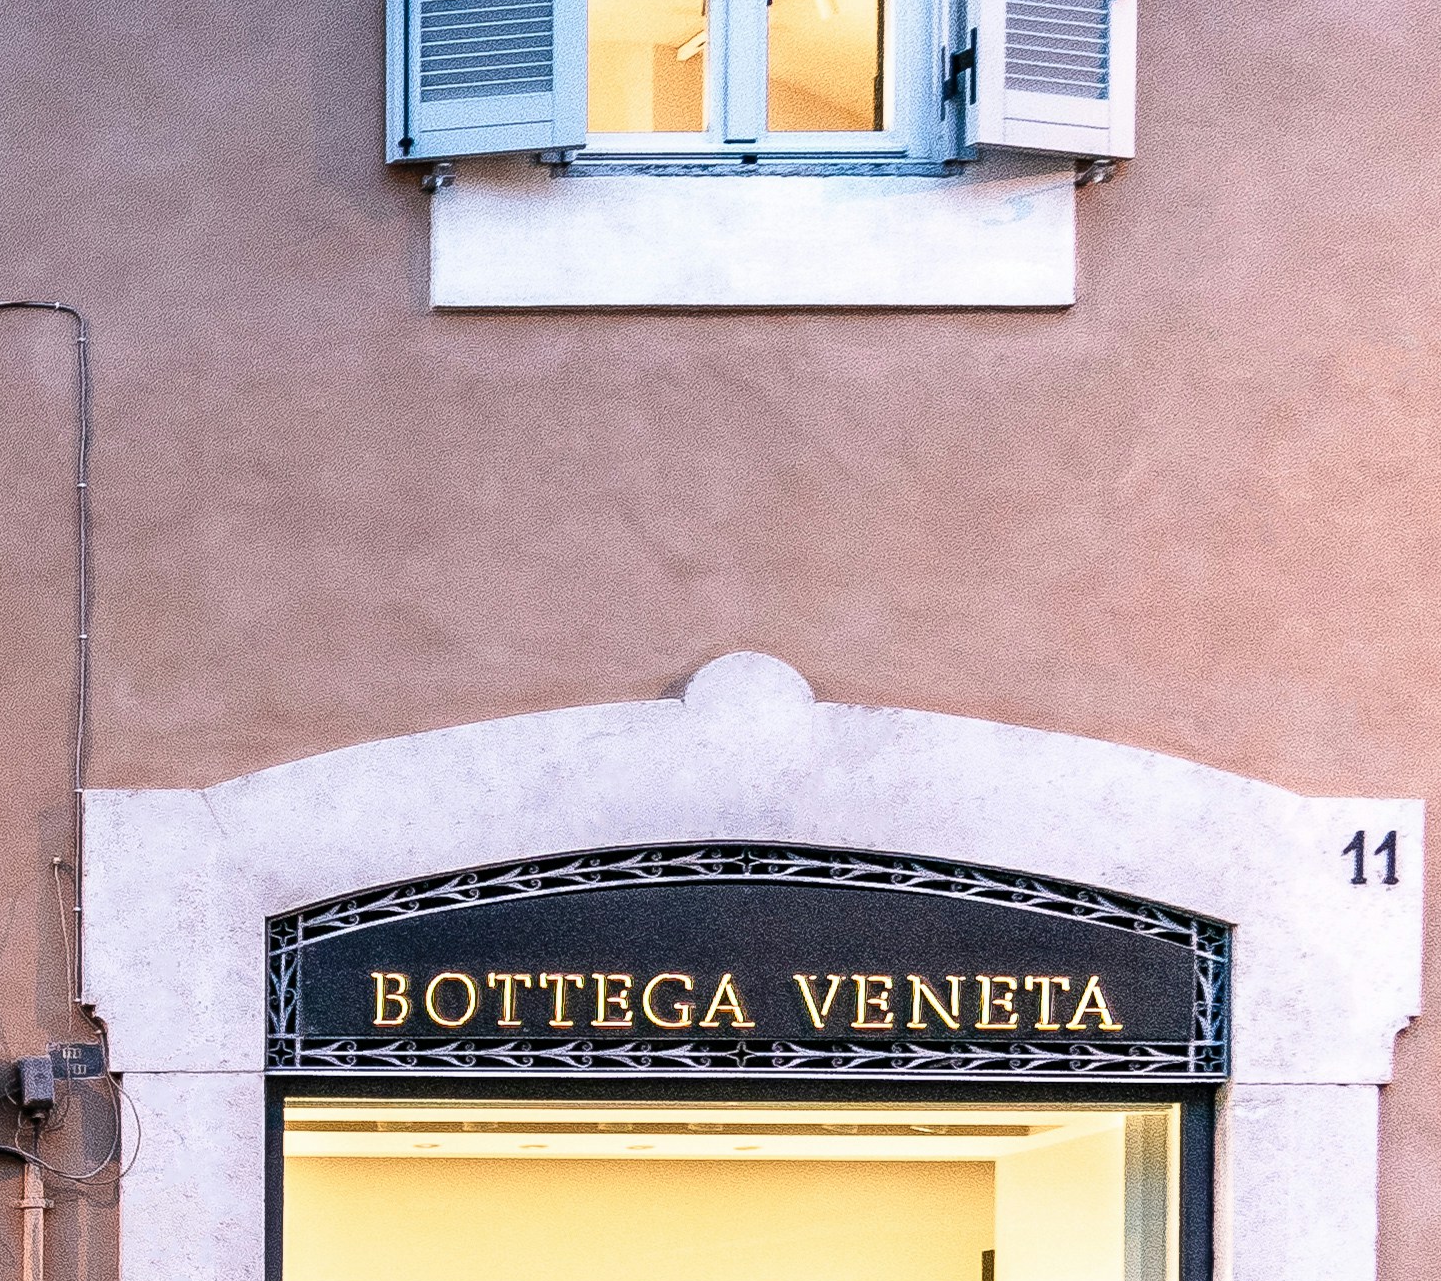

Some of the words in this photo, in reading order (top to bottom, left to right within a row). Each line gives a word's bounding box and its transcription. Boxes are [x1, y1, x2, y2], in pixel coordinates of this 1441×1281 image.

[1340, 829, 1399, 885] 11
[370, 971, 756, 1029] BOTTEGA
[792, 973, 1123, 1031] VENETA
